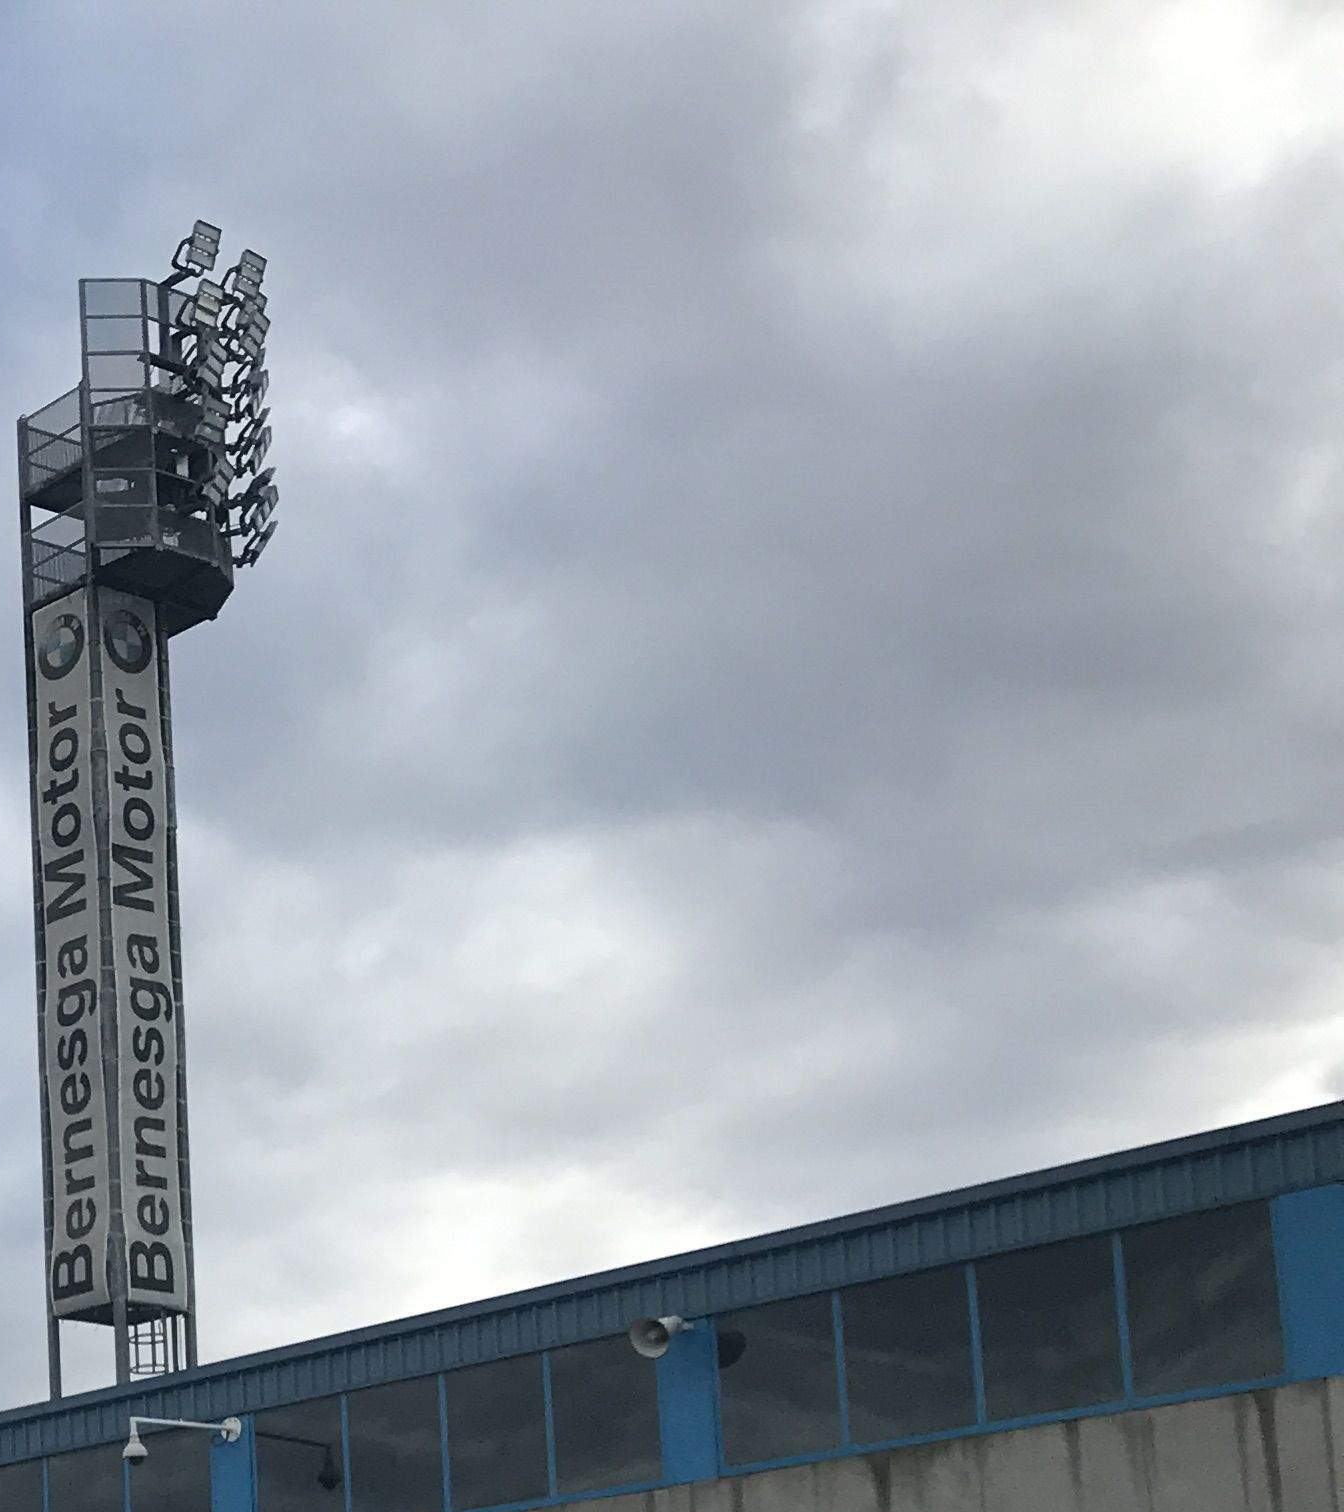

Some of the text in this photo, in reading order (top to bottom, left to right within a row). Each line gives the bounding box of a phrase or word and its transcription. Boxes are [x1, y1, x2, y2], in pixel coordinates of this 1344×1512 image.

[43, 700, 98, 1295] Bernesga Motor
[111, 689, 175, 1295] Bernesga Motor
